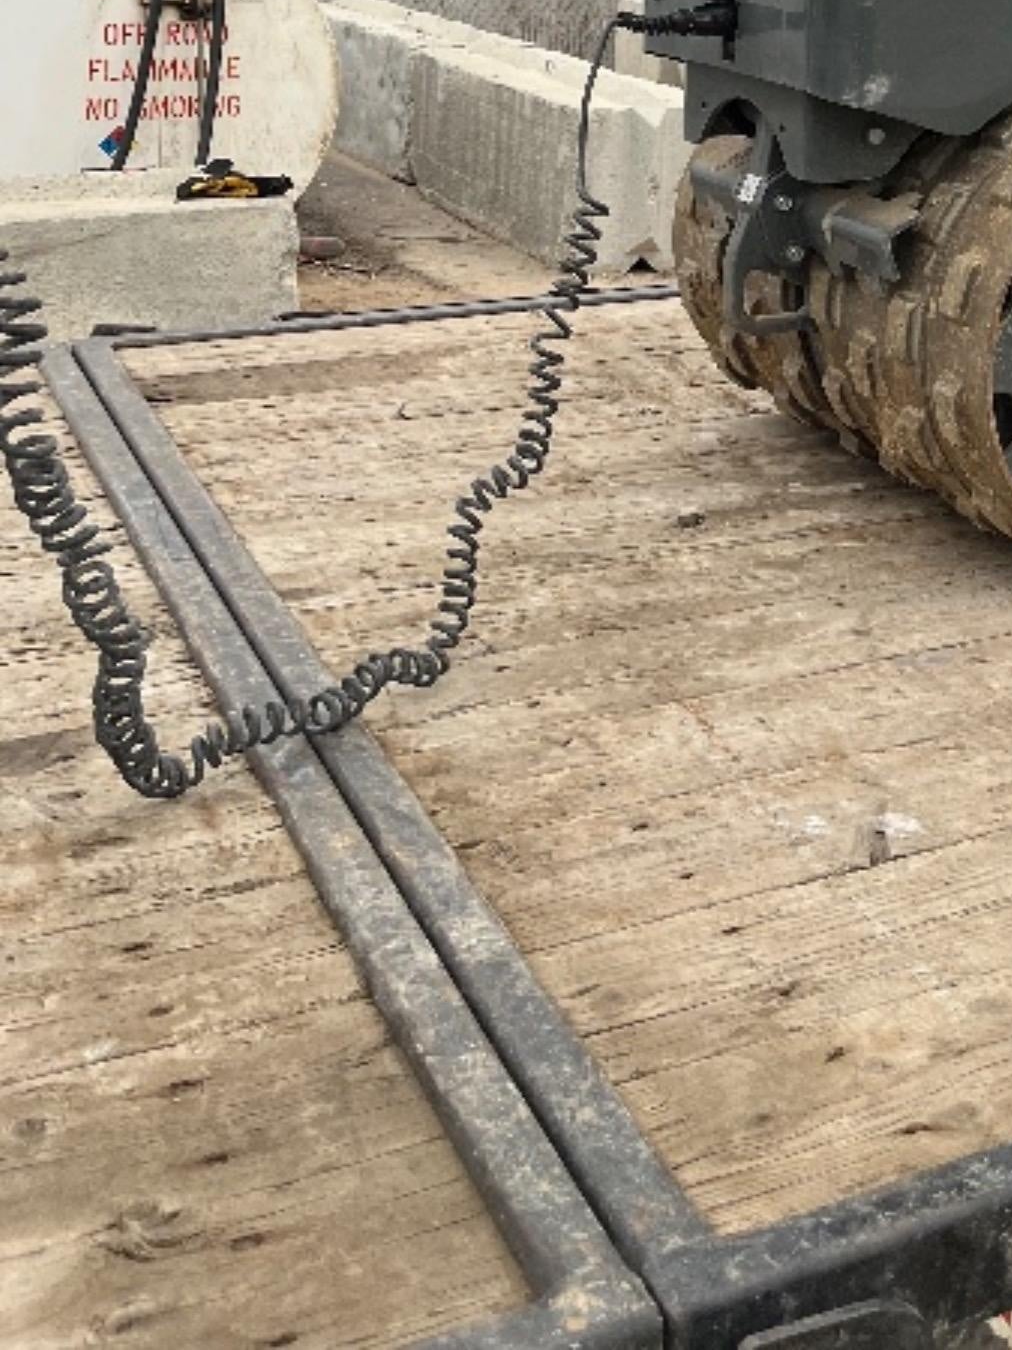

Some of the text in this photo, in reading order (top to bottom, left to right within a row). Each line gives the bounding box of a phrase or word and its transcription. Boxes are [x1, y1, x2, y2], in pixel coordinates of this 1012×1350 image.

[88, 56, 241, 82] FLAMABE
[85, 94, 240, 122] NO SMOKNG
